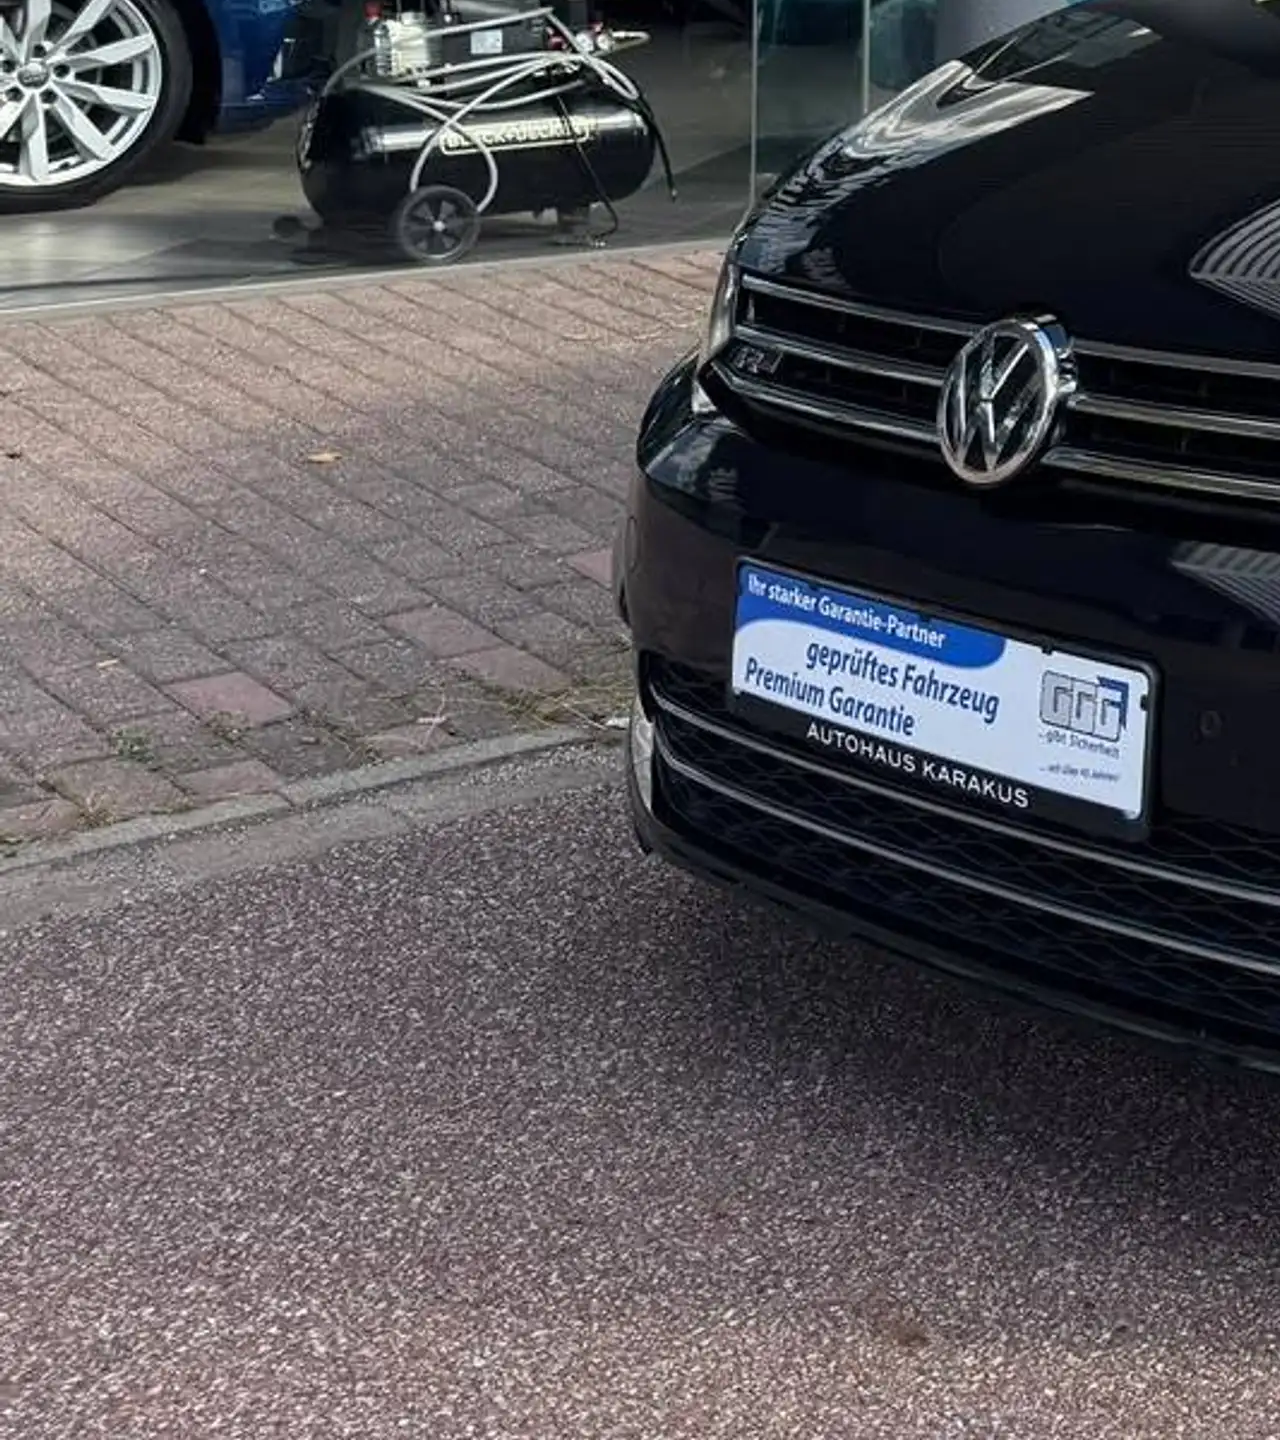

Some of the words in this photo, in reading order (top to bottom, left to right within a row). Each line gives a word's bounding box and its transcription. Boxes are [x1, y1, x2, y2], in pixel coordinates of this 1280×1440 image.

[748, 573, 767, 597] Ihr
[767, 585, 818, 612] starker
[818, 595, 947, 649] Garantie-Partner
[744, 657, 825, 709] Premium
[829, 686, 916, 737] Garantie
[806, 641, 899, 688] geprüftes
[902, 663, 1000, 725] Fahrzeug
[806, 722, 916, 773] AUTOHAUS
[922, 759, 1029, 809] KARAKUS
